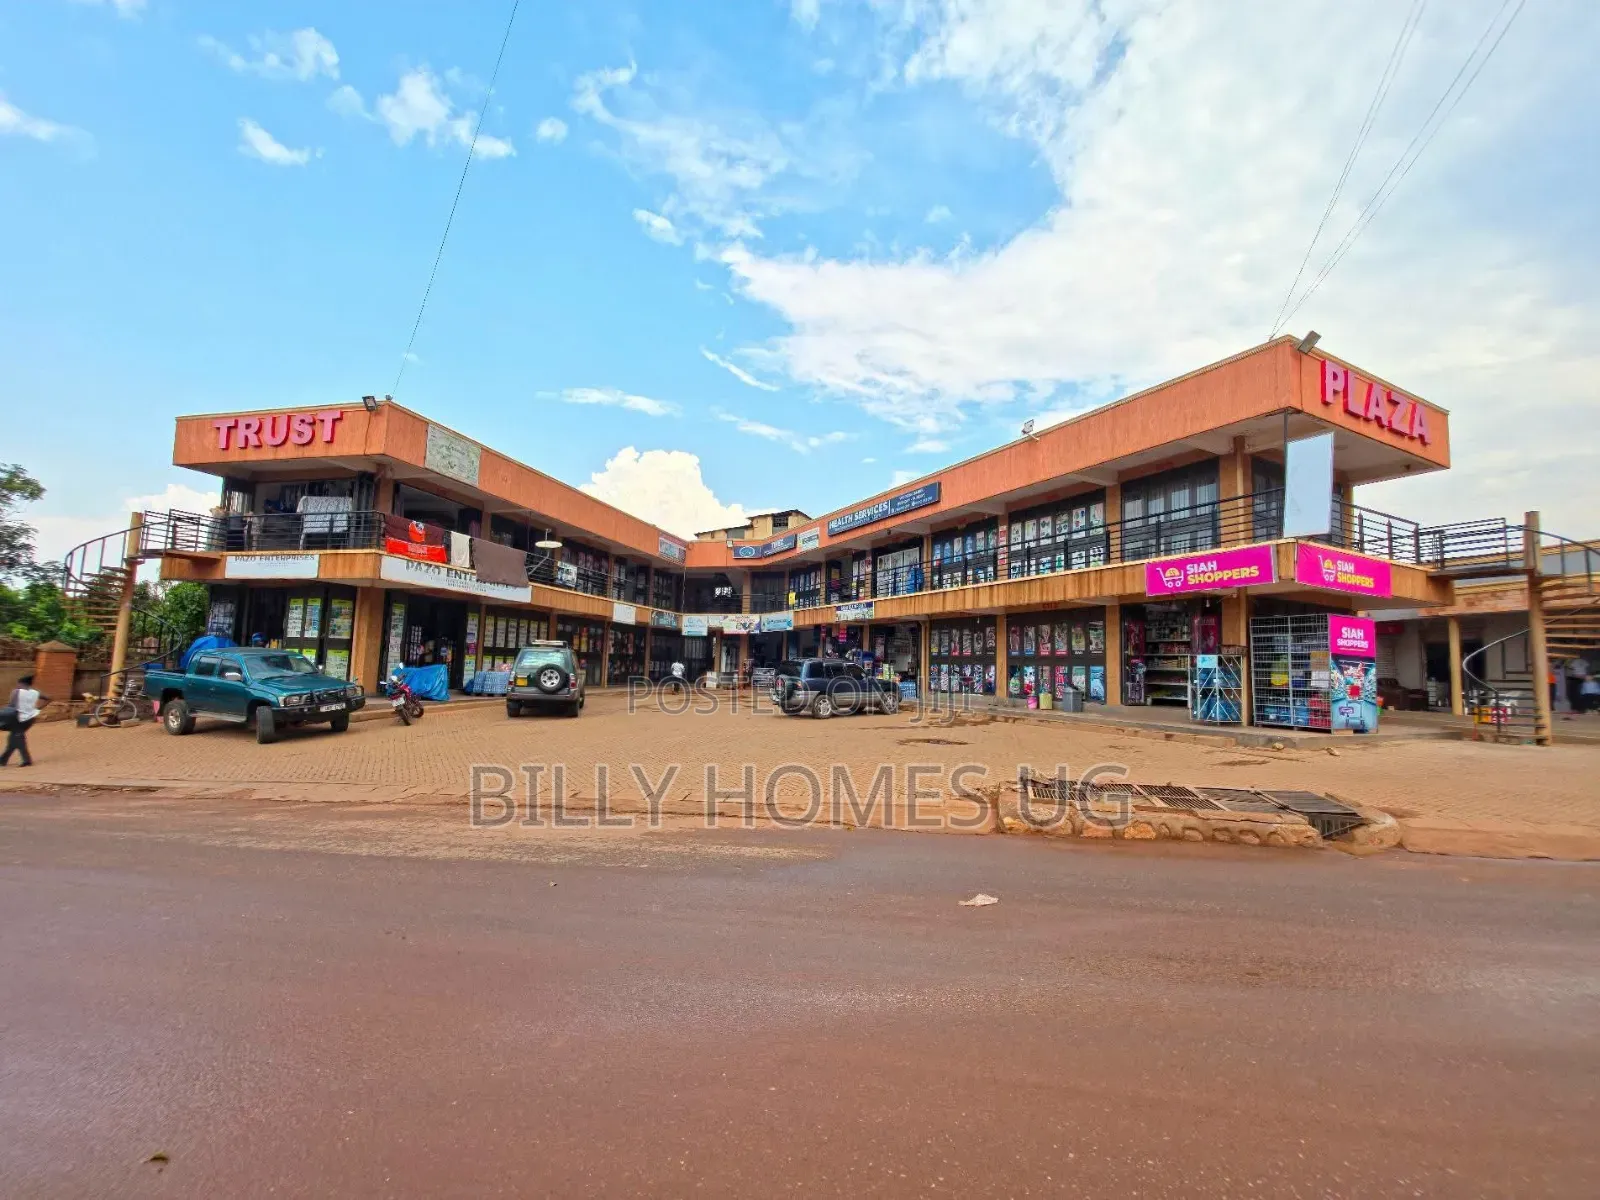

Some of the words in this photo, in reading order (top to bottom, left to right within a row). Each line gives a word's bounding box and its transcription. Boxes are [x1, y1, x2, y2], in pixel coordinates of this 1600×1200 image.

[1321, 360, 1431, 446] PLAZA
[213, 409, 343, 449] TRUST
[829, 514, 853, 530] HEALTH
[854, 501, 888, 521] SERVICES
[260, 554, 315, 562] ENTERPRISES
[405, 560, 441, 576] PAZO
[1186, 560, 1218, 574] SIAH
[1187, 565, 1259, 585] SHOPPERS
[1337, 560, 1355, 574] SIAH
[1337, 572, 1374, 588] SHOPPERS
[1341, 627, 1364, 639] SIAH
[1337, 638, 1369, 649] SHOPPERS
